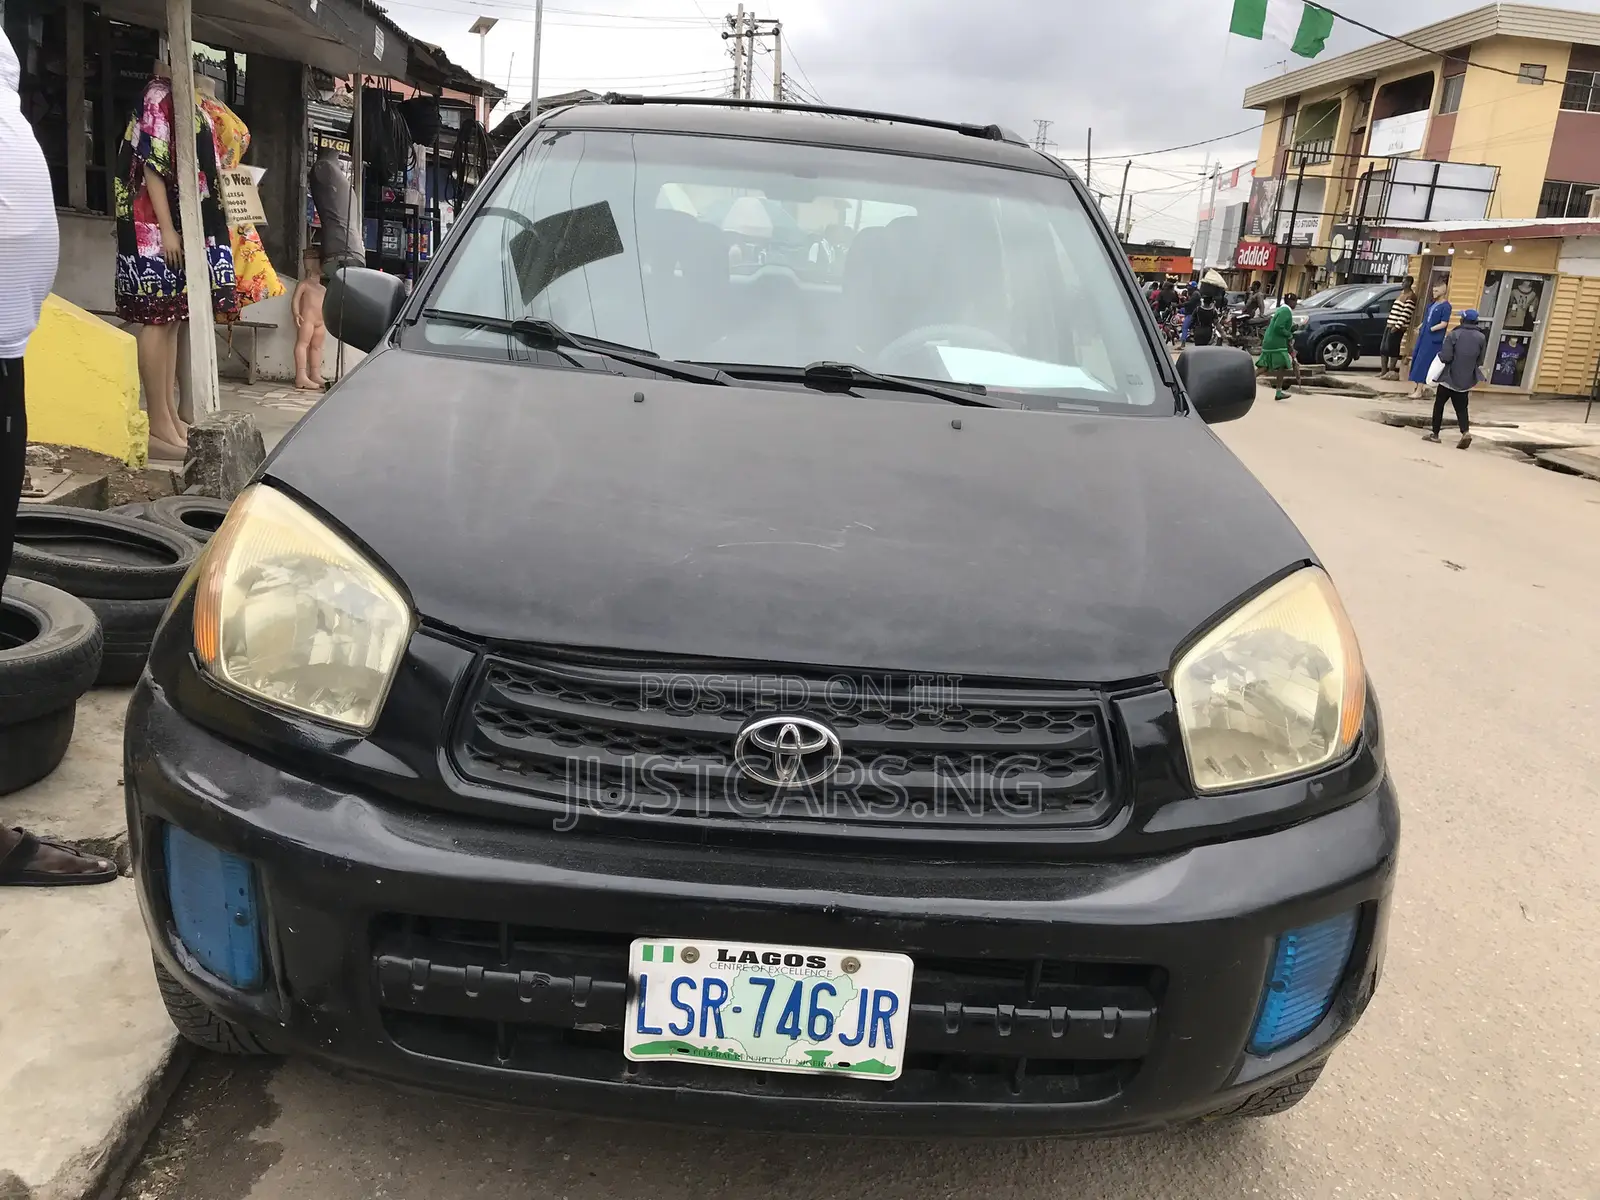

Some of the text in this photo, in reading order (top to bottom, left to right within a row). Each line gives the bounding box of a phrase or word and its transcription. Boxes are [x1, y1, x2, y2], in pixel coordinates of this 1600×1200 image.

[231, 173, 252, 186] Wear
[1238, 245, 1270, 267] addide
[1369, 262, 1389, 274] PLACE
[716, 948, 827, 969] LAGOS
[709, 962, 833, 978] CENTRE OF EXCELLENCE
[636, 973, 899, 1049] LSR-746JR
[692, 1048, 732, 1060] FEDERAL
